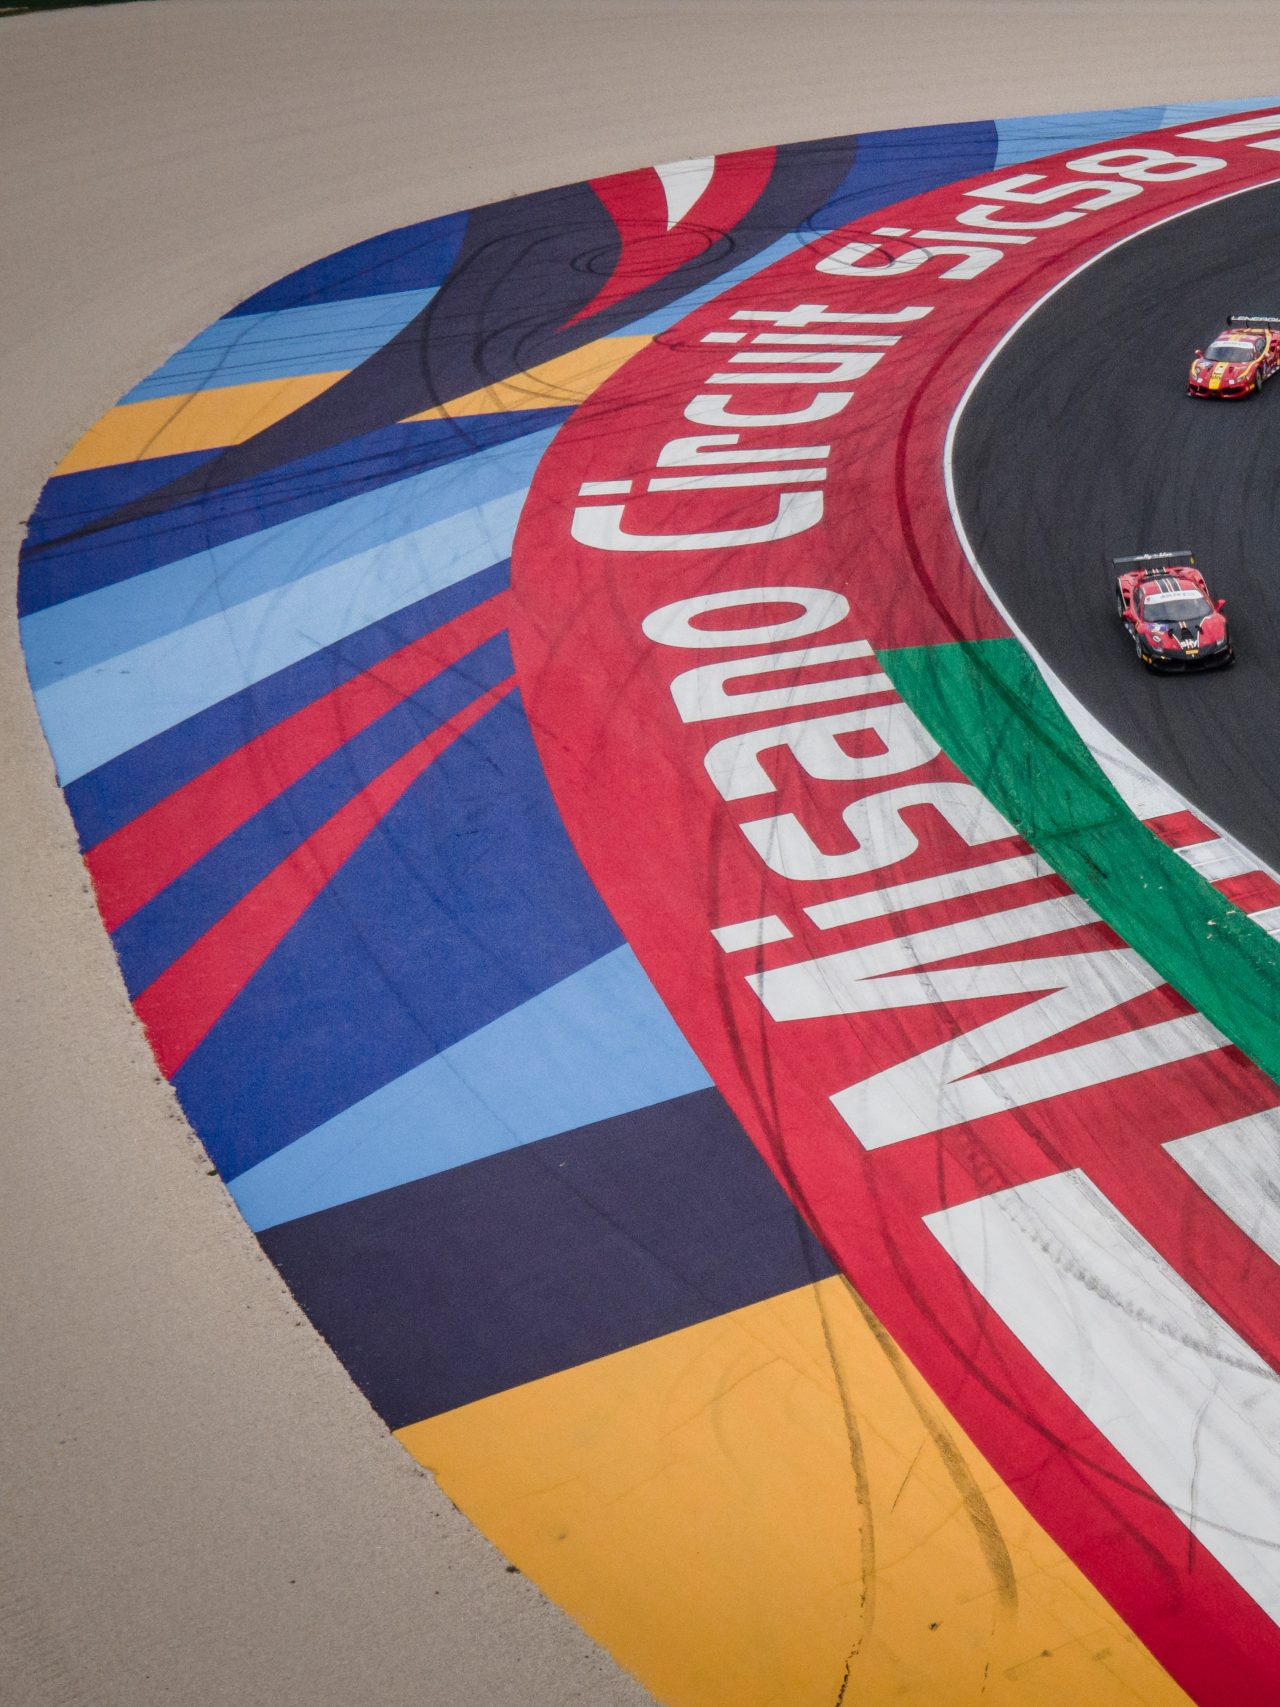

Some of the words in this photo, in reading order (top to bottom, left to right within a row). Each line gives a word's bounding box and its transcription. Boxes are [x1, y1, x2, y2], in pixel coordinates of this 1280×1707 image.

[814, 147, 1228, 281] Sic58
[571, 303, 935, 552] Circuit
[1180, 639, 1198, 649] sky
[641, 586, 1234, 1152] Misano
